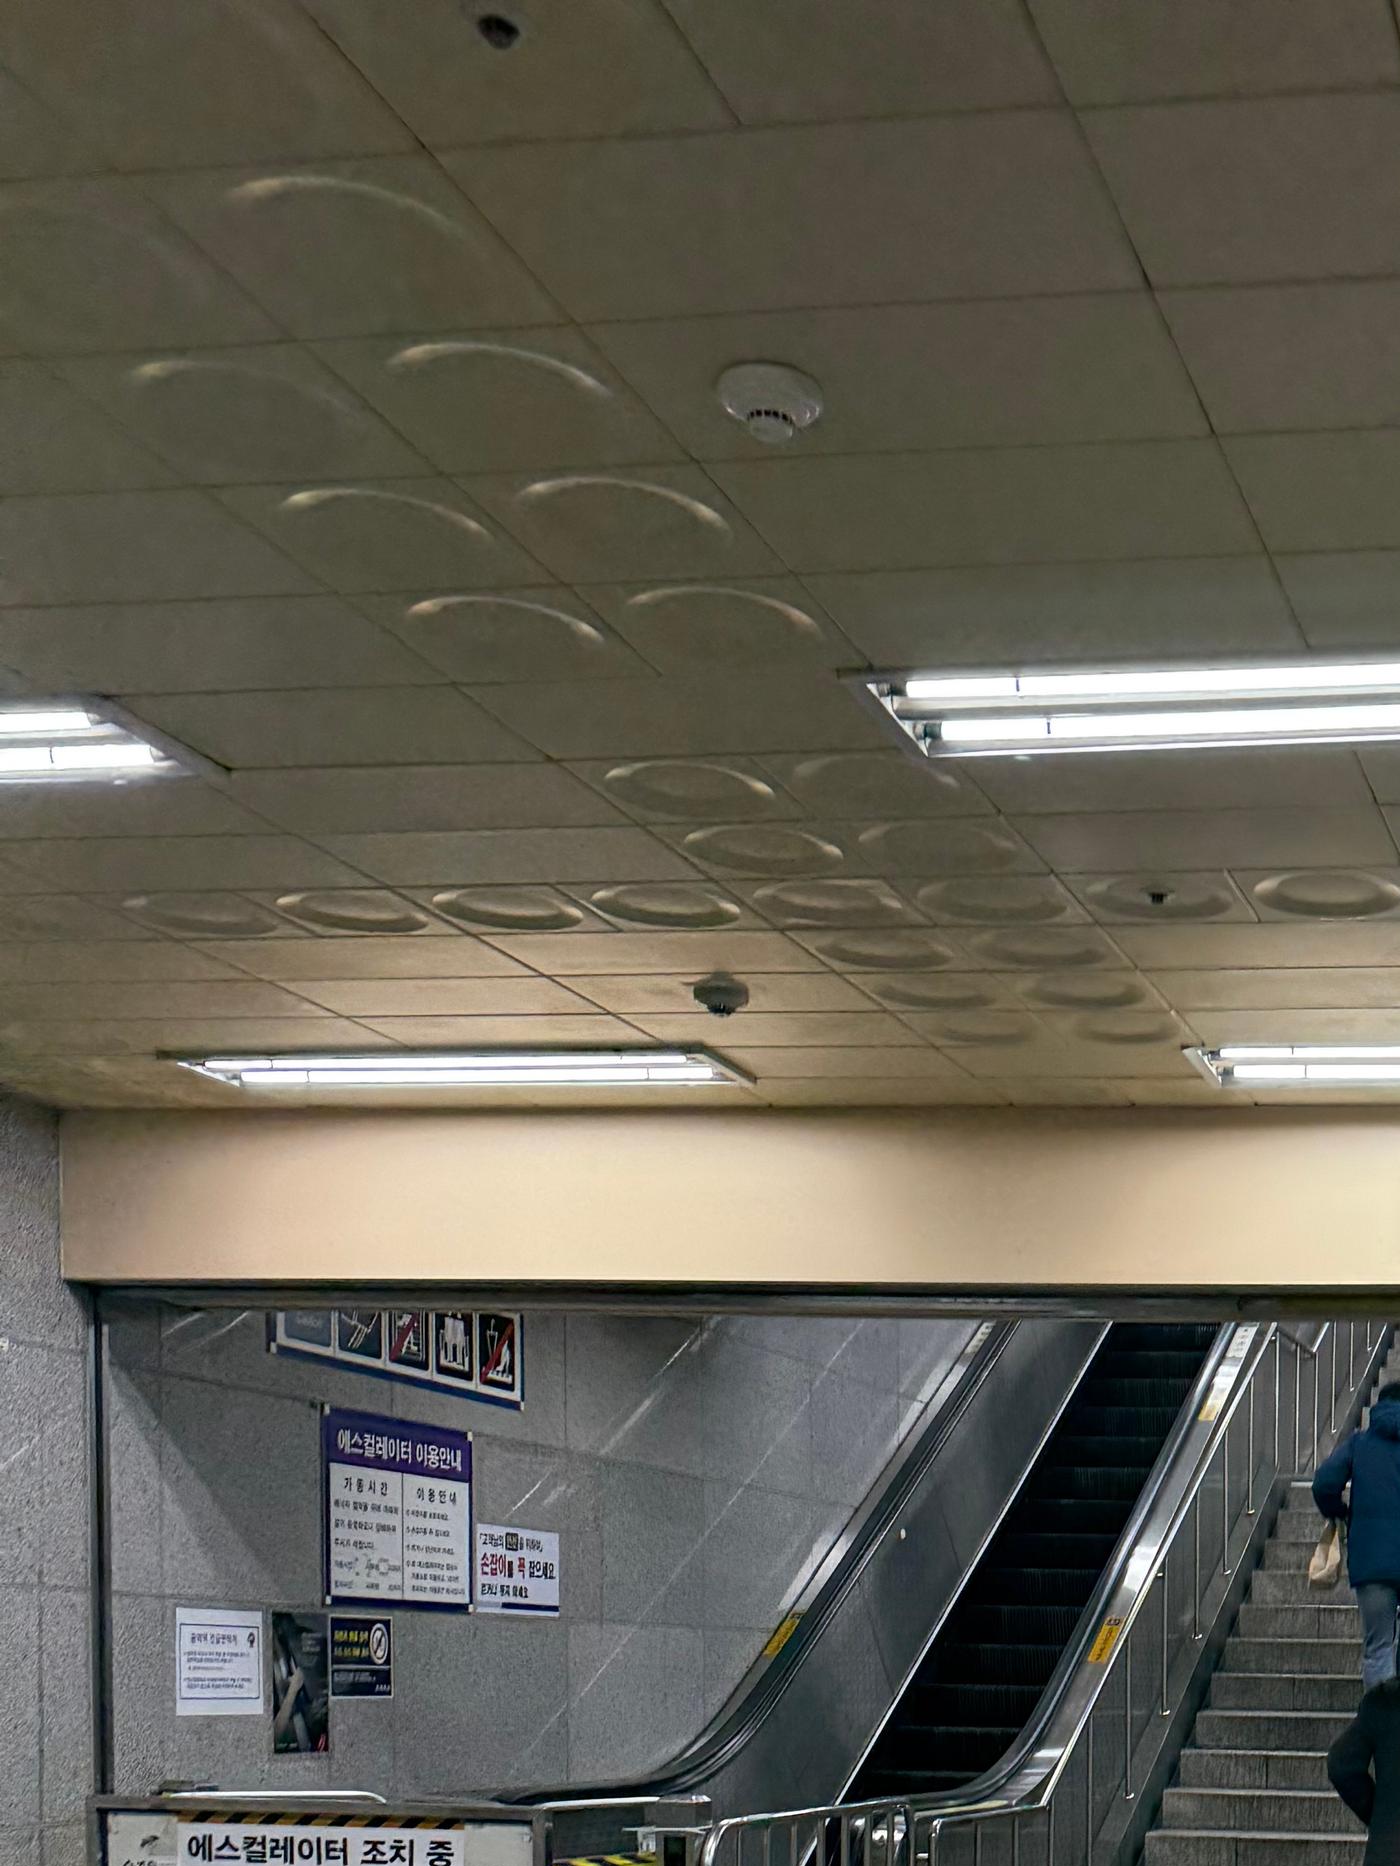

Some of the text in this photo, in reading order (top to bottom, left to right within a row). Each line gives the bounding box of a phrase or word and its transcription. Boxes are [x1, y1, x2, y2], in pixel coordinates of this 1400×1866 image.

[337, 1428, 462, 1472] 에스컬레이터 이용안내
[481, 1552, 514, 1579] 손잡이를
[529, 1560, 556, 1580] 잡으세요
[187, 1833, 348, 1866] 에스컬레이터
